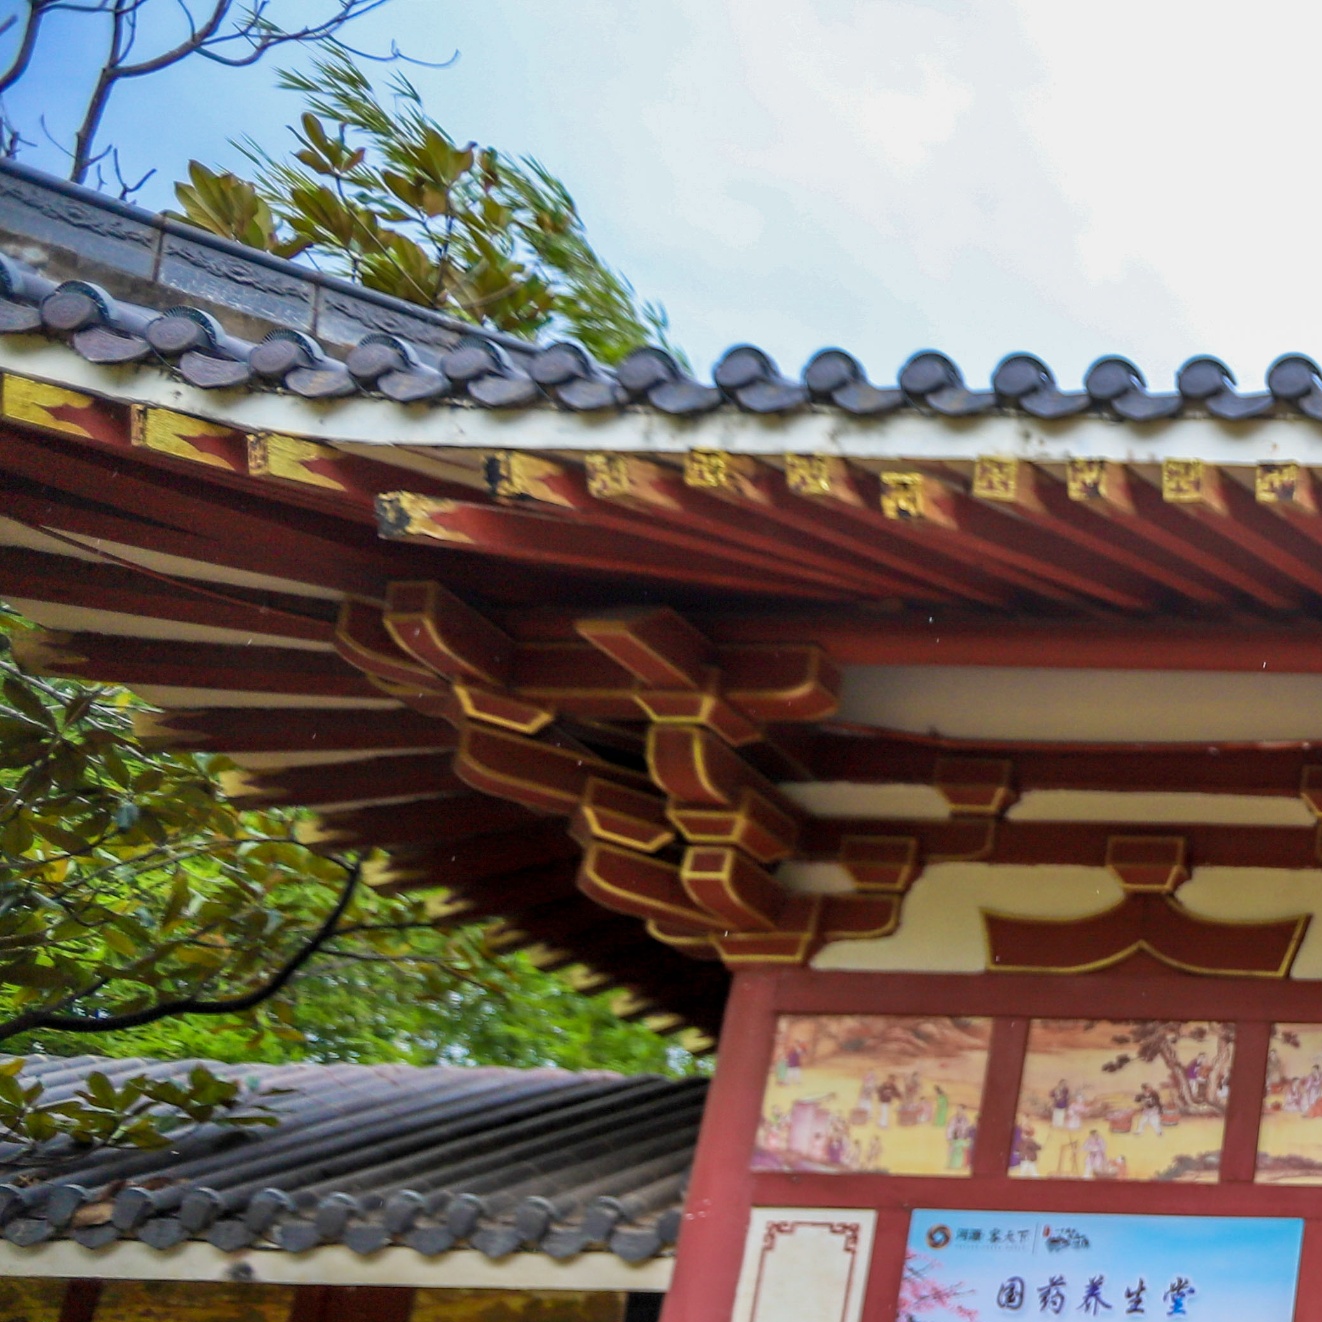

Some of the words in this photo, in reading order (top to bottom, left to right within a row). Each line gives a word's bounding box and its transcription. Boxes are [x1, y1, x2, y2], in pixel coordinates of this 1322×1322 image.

[997, 1274, 1196, 1316] 国药养生堂
